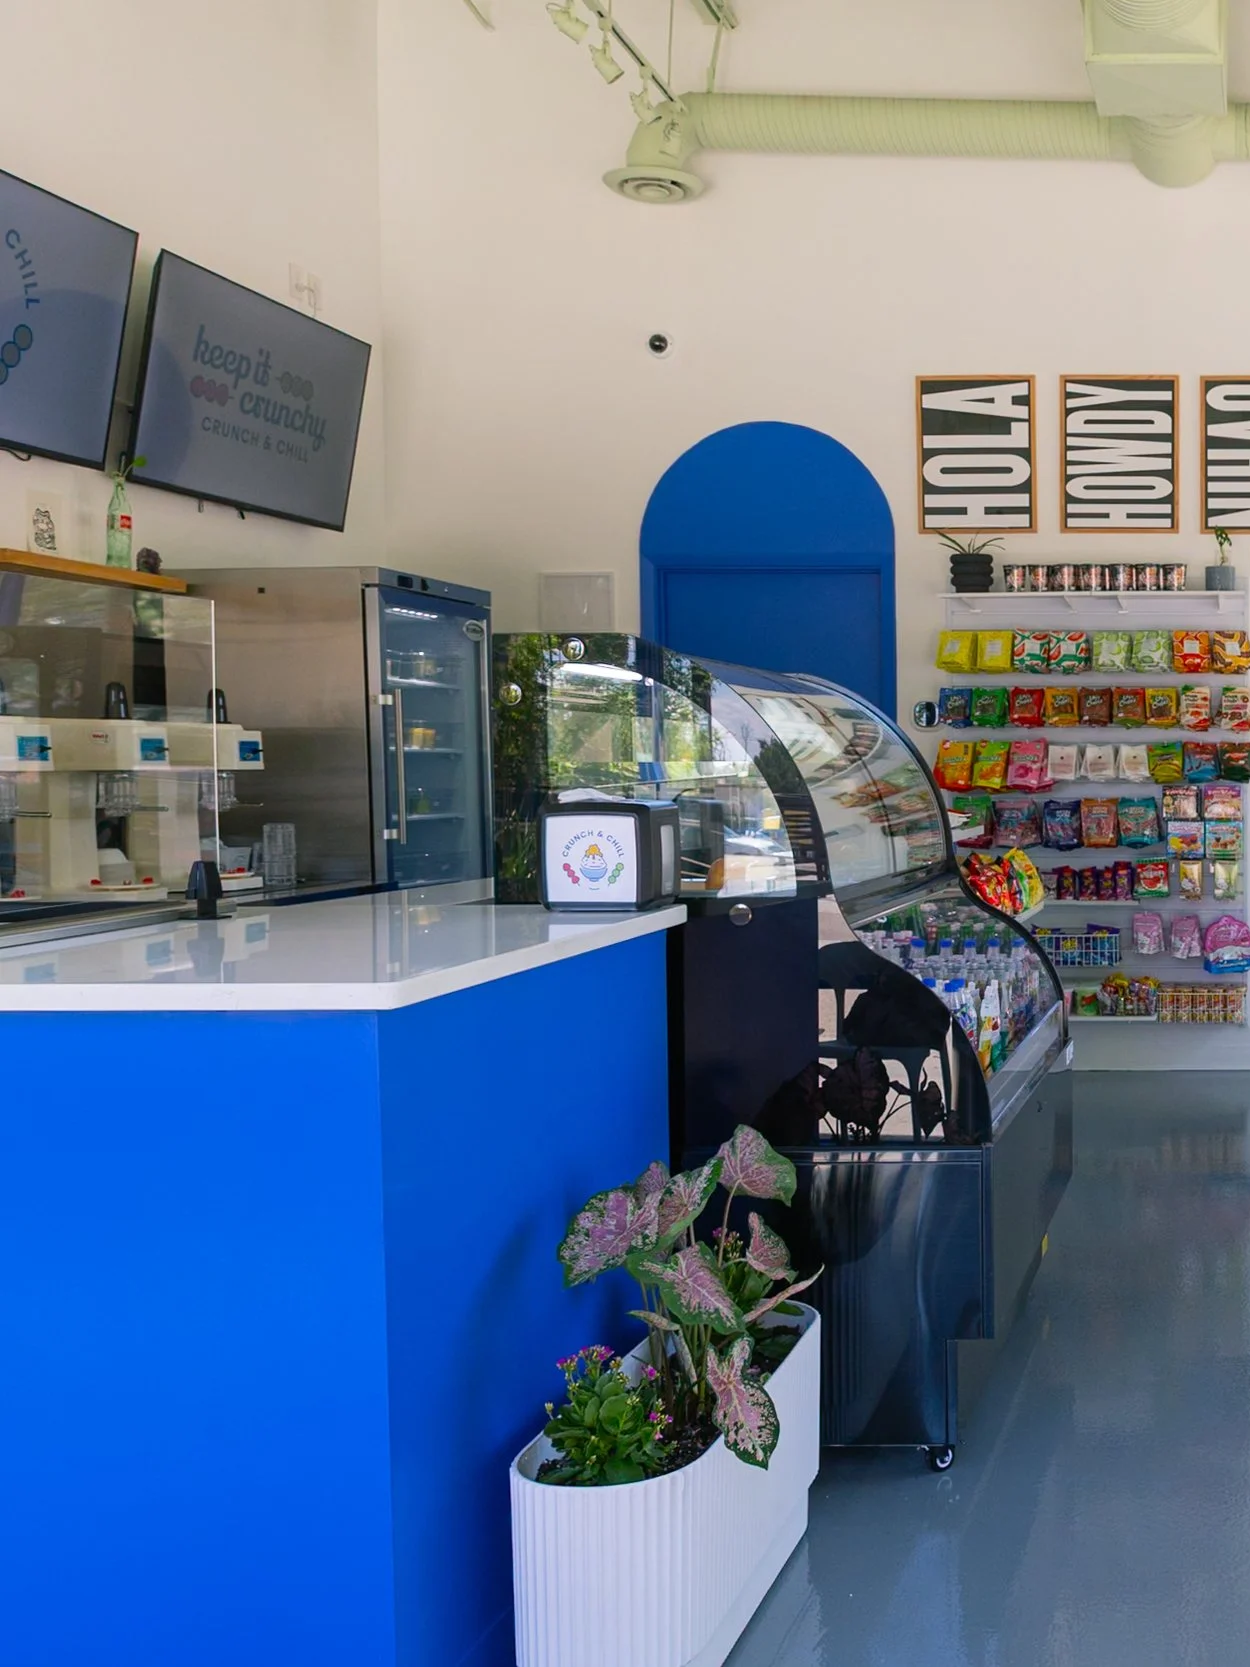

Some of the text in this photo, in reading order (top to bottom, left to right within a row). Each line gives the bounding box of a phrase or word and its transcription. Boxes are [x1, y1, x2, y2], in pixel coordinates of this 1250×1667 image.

[5, 228, 40, 310] CHILL
[192, 323, 272, 391] keep it
[201, 416, 308, 464] CRUNCH & CHILL
[239, 391, 327, 452] crunchy
[921, 381, 1031, 529] HOLA
[1065, 382, 1174, 528] HOWDY
[562, 829, 594, 857] CRUNCH
[606, 834, 625, 858] CHILL
